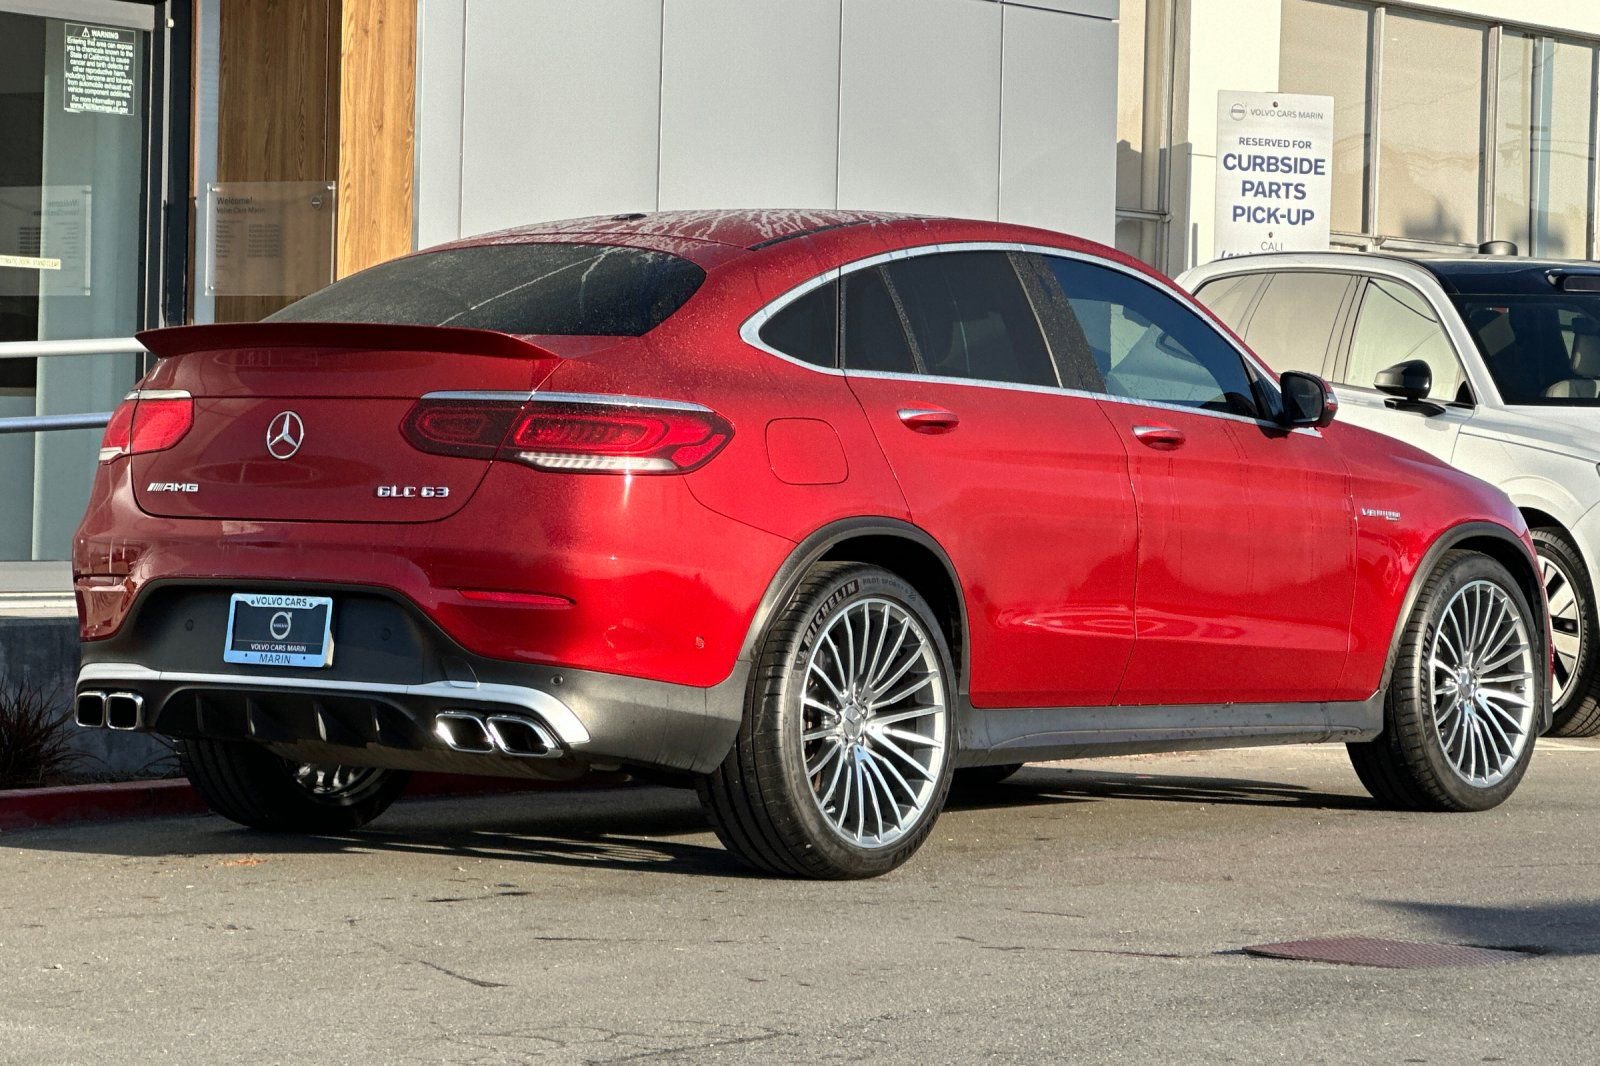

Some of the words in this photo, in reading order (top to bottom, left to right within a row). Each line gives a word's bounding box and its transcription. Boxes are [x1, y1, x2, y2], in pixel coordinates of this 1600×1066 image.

[91, 30, 119, 40] WARNING
[67, 36, 86, 46] Entering
[89, 53, 110, 62] California
[66, 72, 85, 81] including
[92, 97, 115, 105] information
[1250, 108, 1275, 117] VOLVO
[1277, 110, 1297, 118] CARS
[1298, 112, 1324, 120] MARIN
[1239, 137, 1290, 148] RESERVED
[1292, 140, 1312, 149] FOR
[1223, 153, 1326, 176] CURBSIDE
[1241, 180, 1306, 200] PARTS
[217, 196, 252, 205] Welcome!
[1232, 205, 1315, 226] PICK-UP
[1260, 242, 1283, 252] CALL
[162, 483, 198, 492] AMG
[378, 485, 416, 497] GLC
[421, 486, 449, 498] 63
[256, 596, 283, 606] VOLVO
[285, 598, 307, 607] CARS
[803, 580, 857, 648] MICHELIN
[260, 654, 291, 664] MARIN
